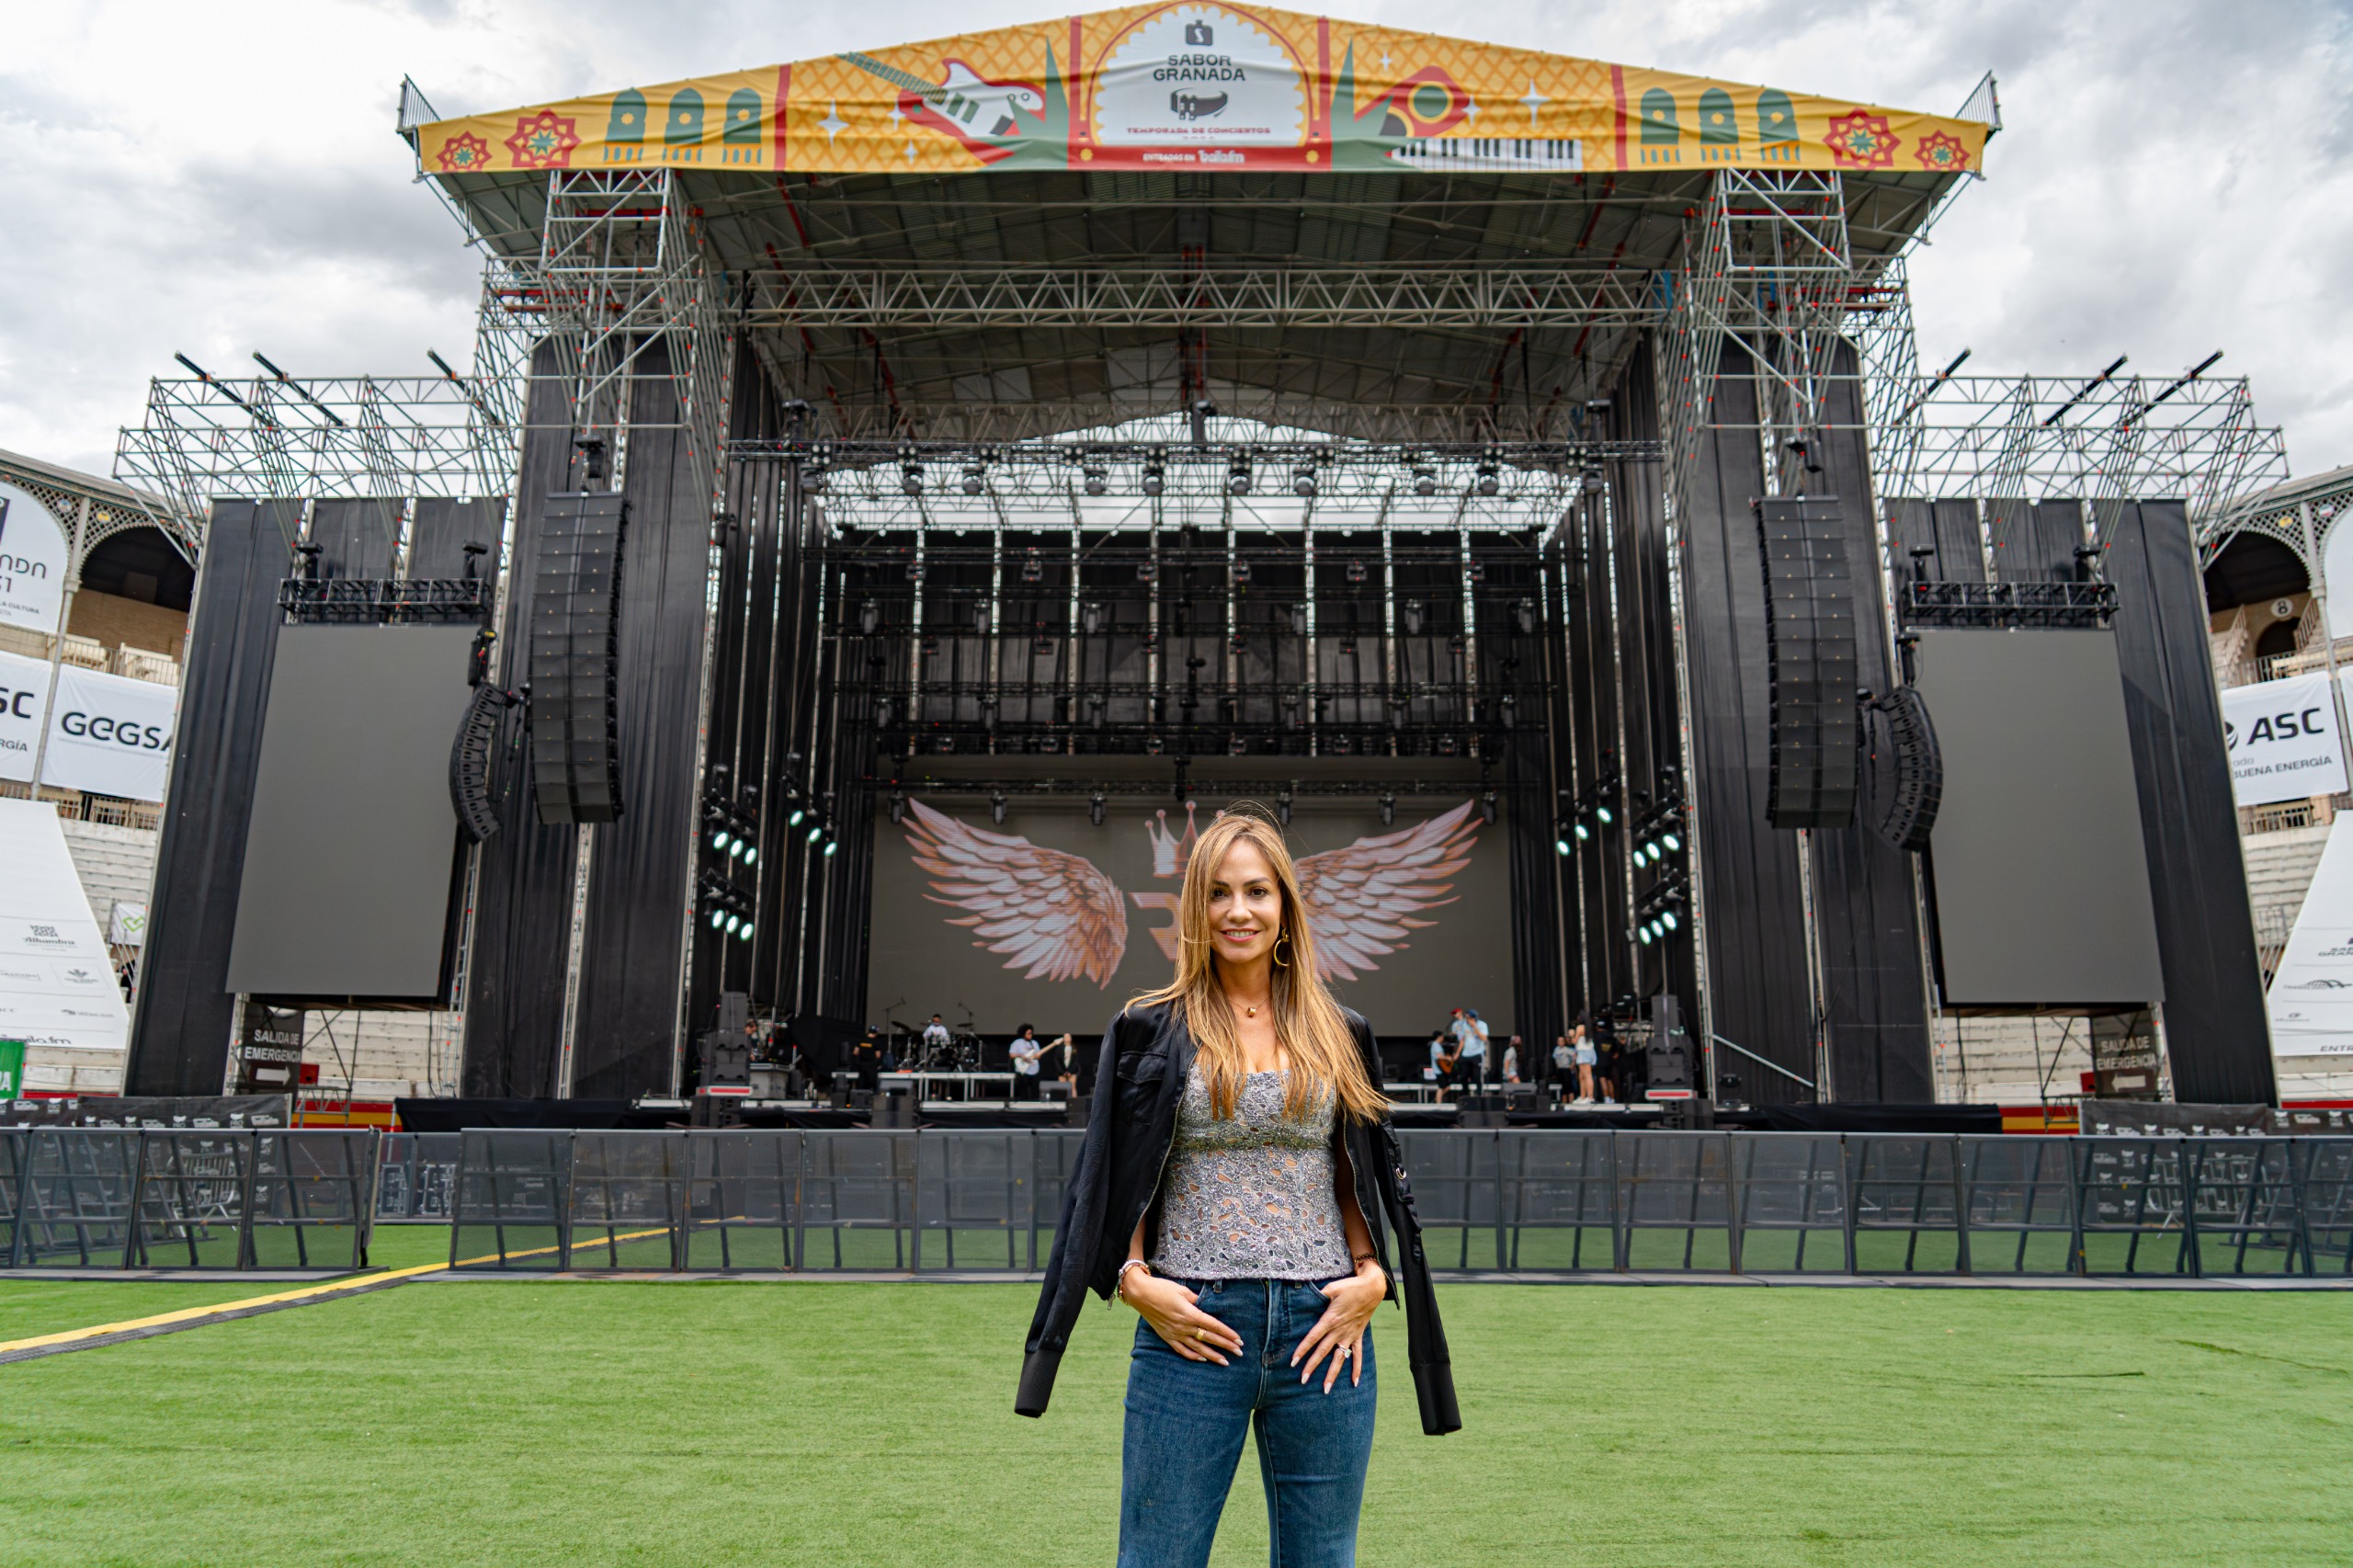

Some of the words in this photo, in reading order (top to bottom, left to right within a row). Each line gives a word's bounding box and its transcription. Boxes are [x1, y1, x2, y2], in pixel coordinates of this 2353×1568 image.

[1167, 54, 1232, 66] SABOR
[1153, 68, 1245, 81] GRANADA
[7, 602, 40, 615] CULTURA
[2278, 600, 2289, 615] 8
[2246, 707, 2325, 745] ASC
[2275, 755, 2333, 773] ENERGÍA
[254, 1029, 290, 1044] SALIDA
[290, 1032, 300, 1046] DE
[2137, 1035, 2150, 1050] DE
[244, 1046, 301, 1063] EMERGENCIA
[2097, 1052, 2157, 1072] EMERGENCIA
